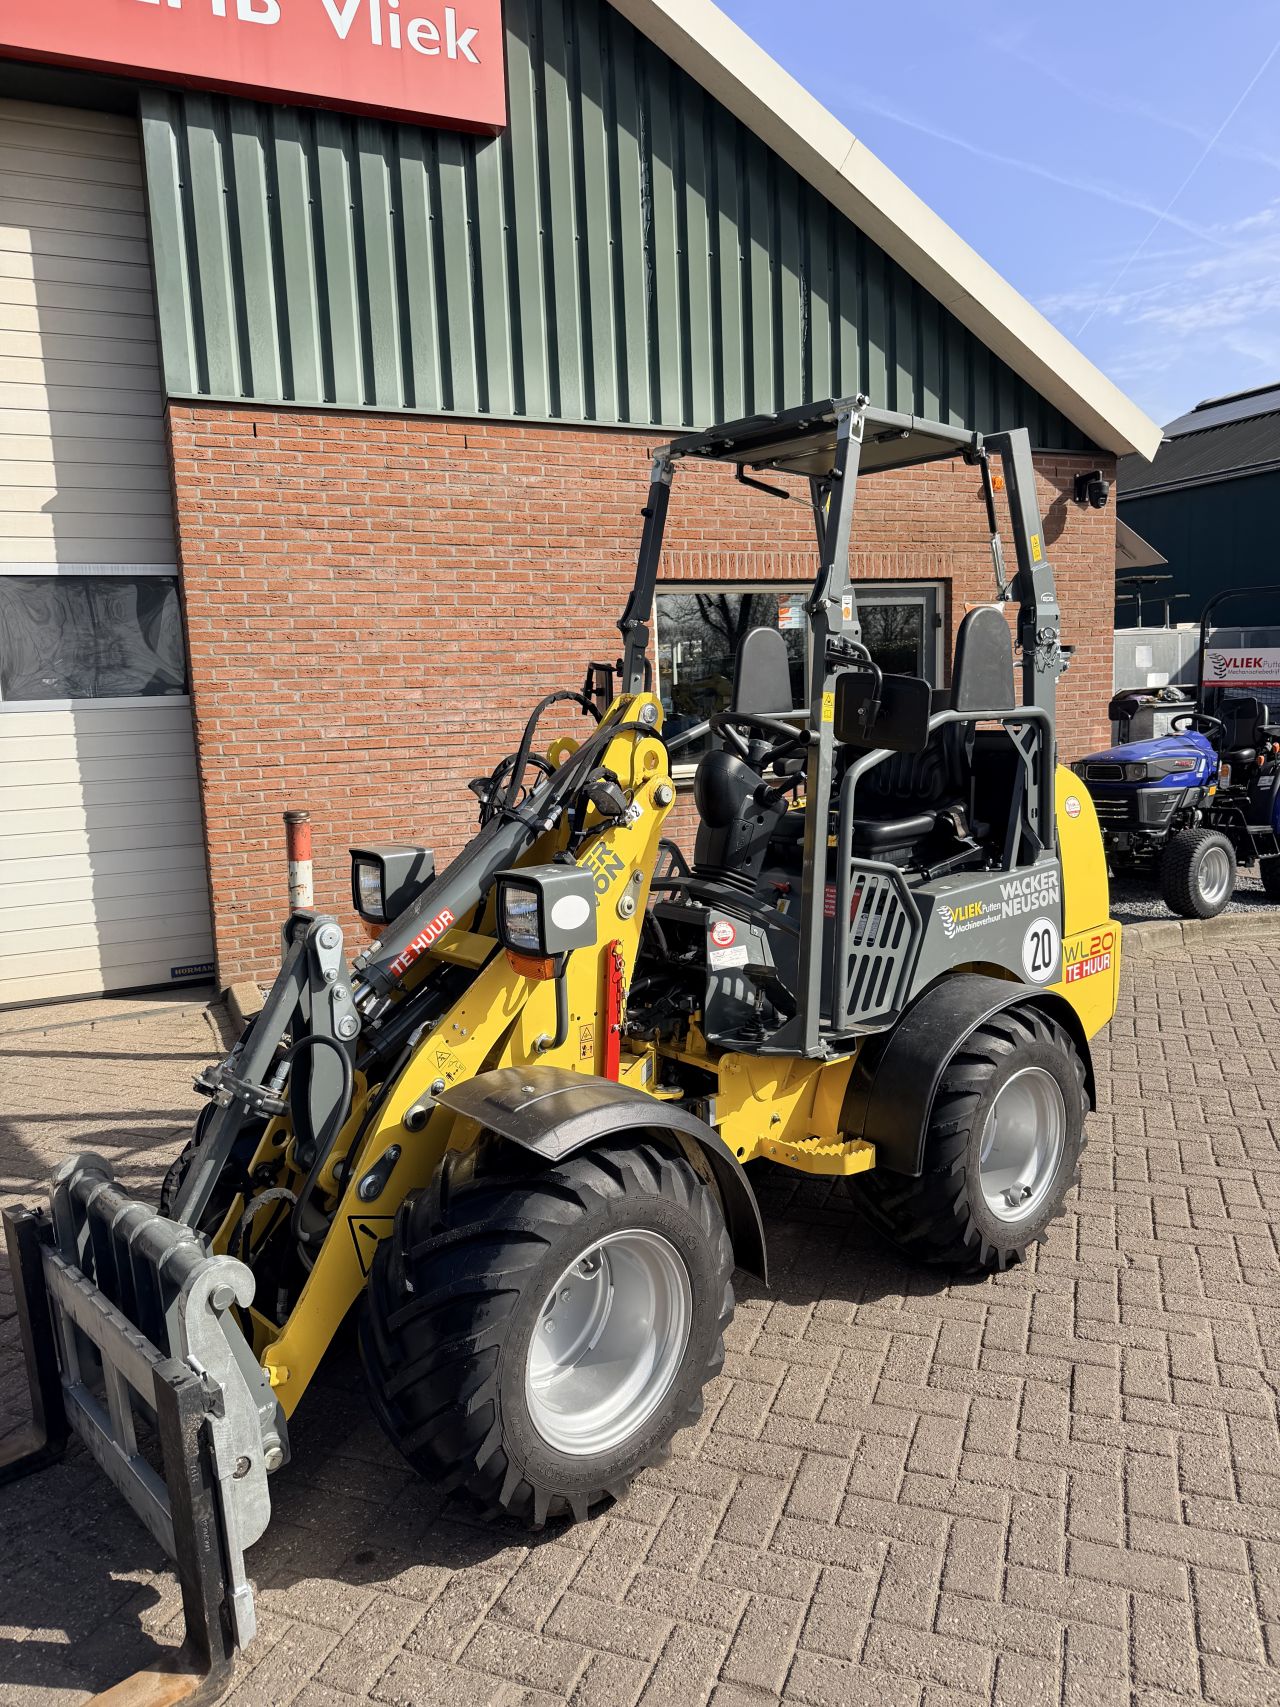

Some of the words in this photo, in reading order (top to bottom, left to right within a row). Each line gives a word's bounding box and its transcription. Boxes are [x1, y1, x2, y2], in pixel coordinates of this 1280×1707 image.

[323, 0, 482, 64] Vliek
[1225, 657, 1263, 668] VLIEK
[1000, 870, 1059, 900] WACKER
[952, 901, 983, 923] VLIEK
[982, 902, 1001, 914] Putten
[1001, 886, 1060, 919] NEUSON
[955, 913, 1001, 934] Machineverhuur
[390, 951, 414, 974] TE
[411, 910, 455, 955] HUUR
[1030, 928, 1052, 973] 20
[1064, 931, 1114, 963] WL20
[1066, 963, 1081, 982] TE
[1082, 953, 1111, 977] HUUR
